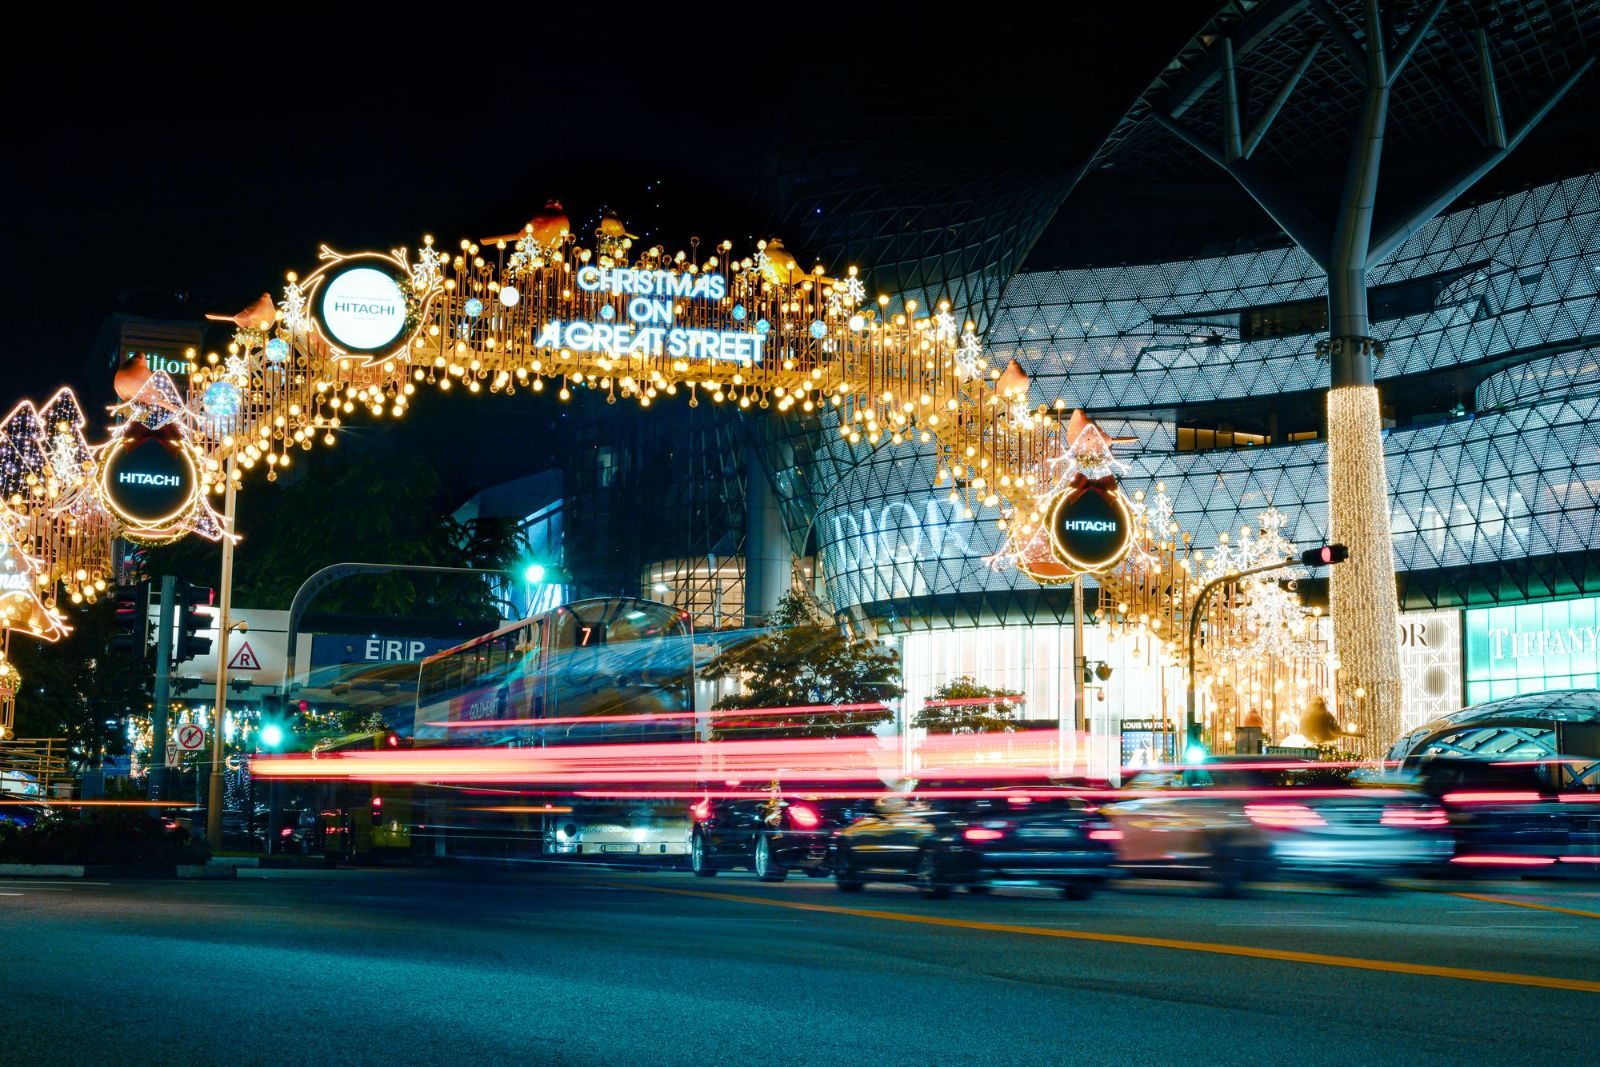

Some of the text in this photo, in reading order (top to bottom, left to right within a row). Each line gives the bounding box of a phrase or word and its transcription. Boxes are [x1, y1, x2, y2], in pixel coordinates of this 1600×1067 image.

[577, 266, 725, 299] CHRISTMAS
[335, 302, 395, 315] HITACHI
[629, 297, 672, 323] ON
[536, 321, 766, 361] A GREAT STREET
[128, 351, 191, 374] ilton
[119, 472, 180, 487] HITACHI
[1065, 520, 1116, 532] HITACHI
[582, 627, 592, 646] 7
[1488, 626, 1600, 660] TIFFANY
[240, 653, 250, 666] R
[1123, 721, 1142, 729] LOUIS
